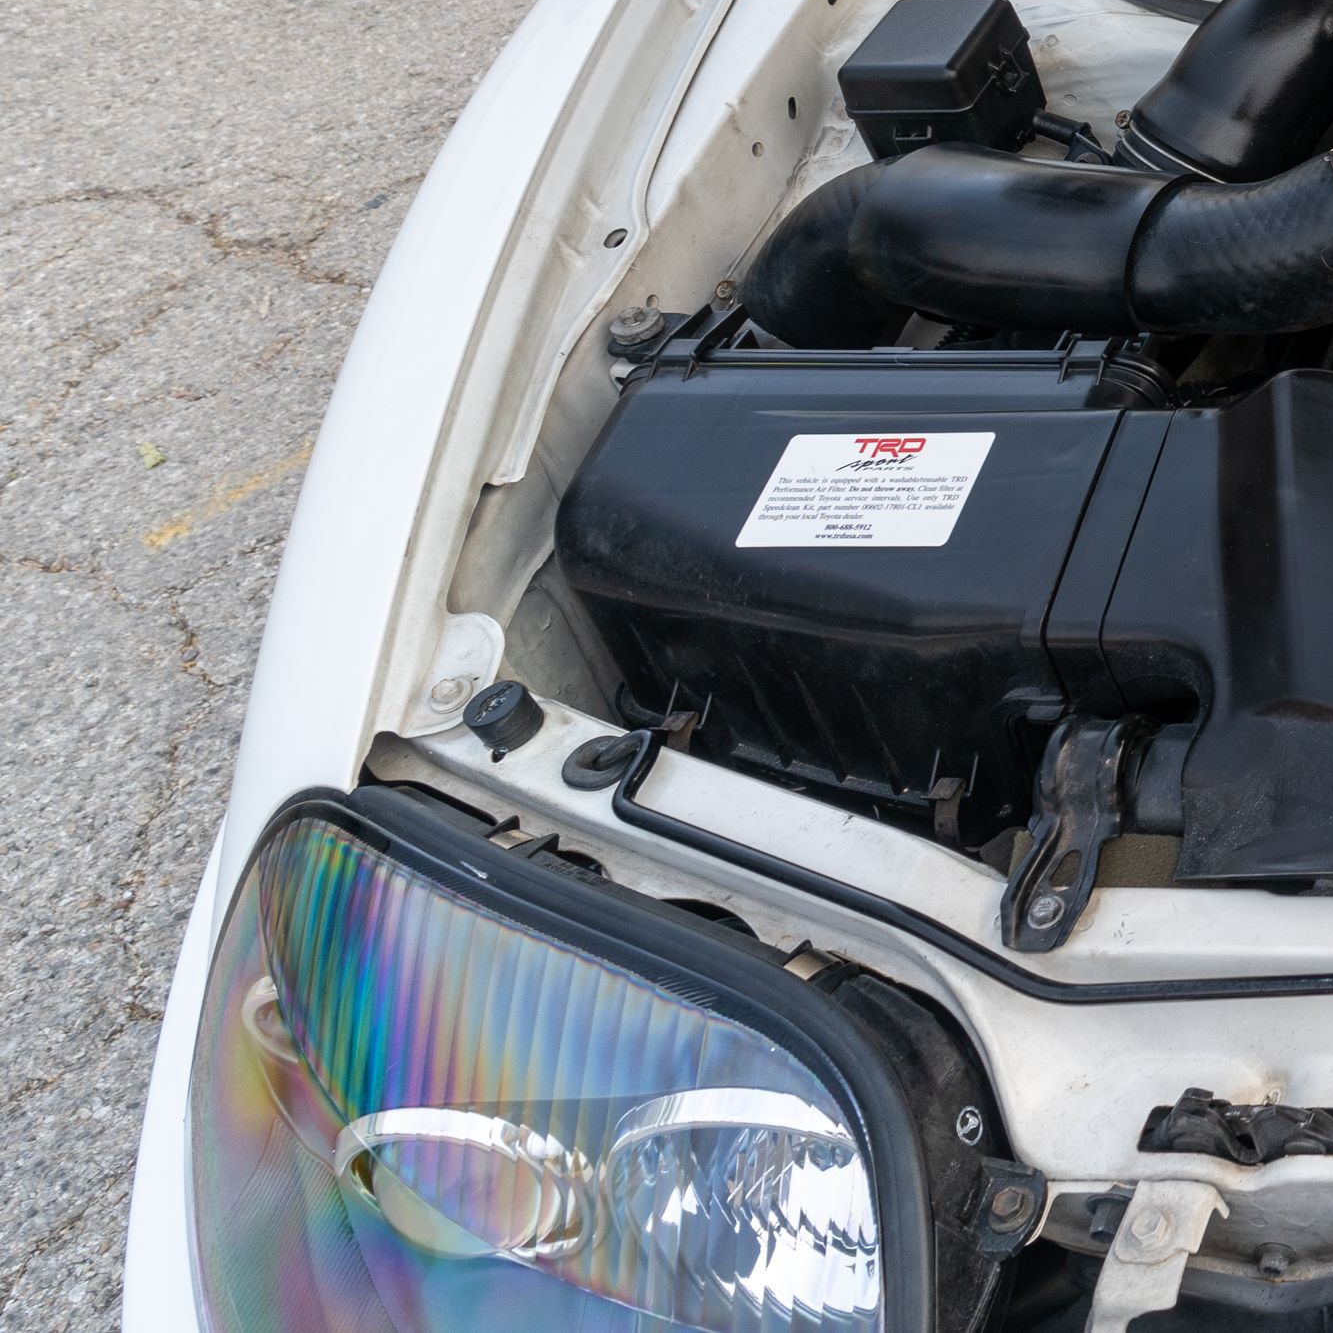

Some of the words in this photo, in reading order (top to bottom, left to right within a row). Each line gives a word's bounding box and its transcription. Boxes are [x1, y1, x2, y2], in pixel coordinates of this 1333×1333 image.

[854, 438, 926, 458] TRD
[835, 454, 917, 472] sport
[830, 477, 861, 486] equipped
[818, 495, 841, 503] Toyota
[922, 494, 938, 502] only
[762, 504, 800, 512] Speedclean
[817, 504, 832, 512] part
[757, 513, 784, 521] through
[819, 513, 842, 521] Toyota
[824, 523, 872, 531] 800-688-5912
